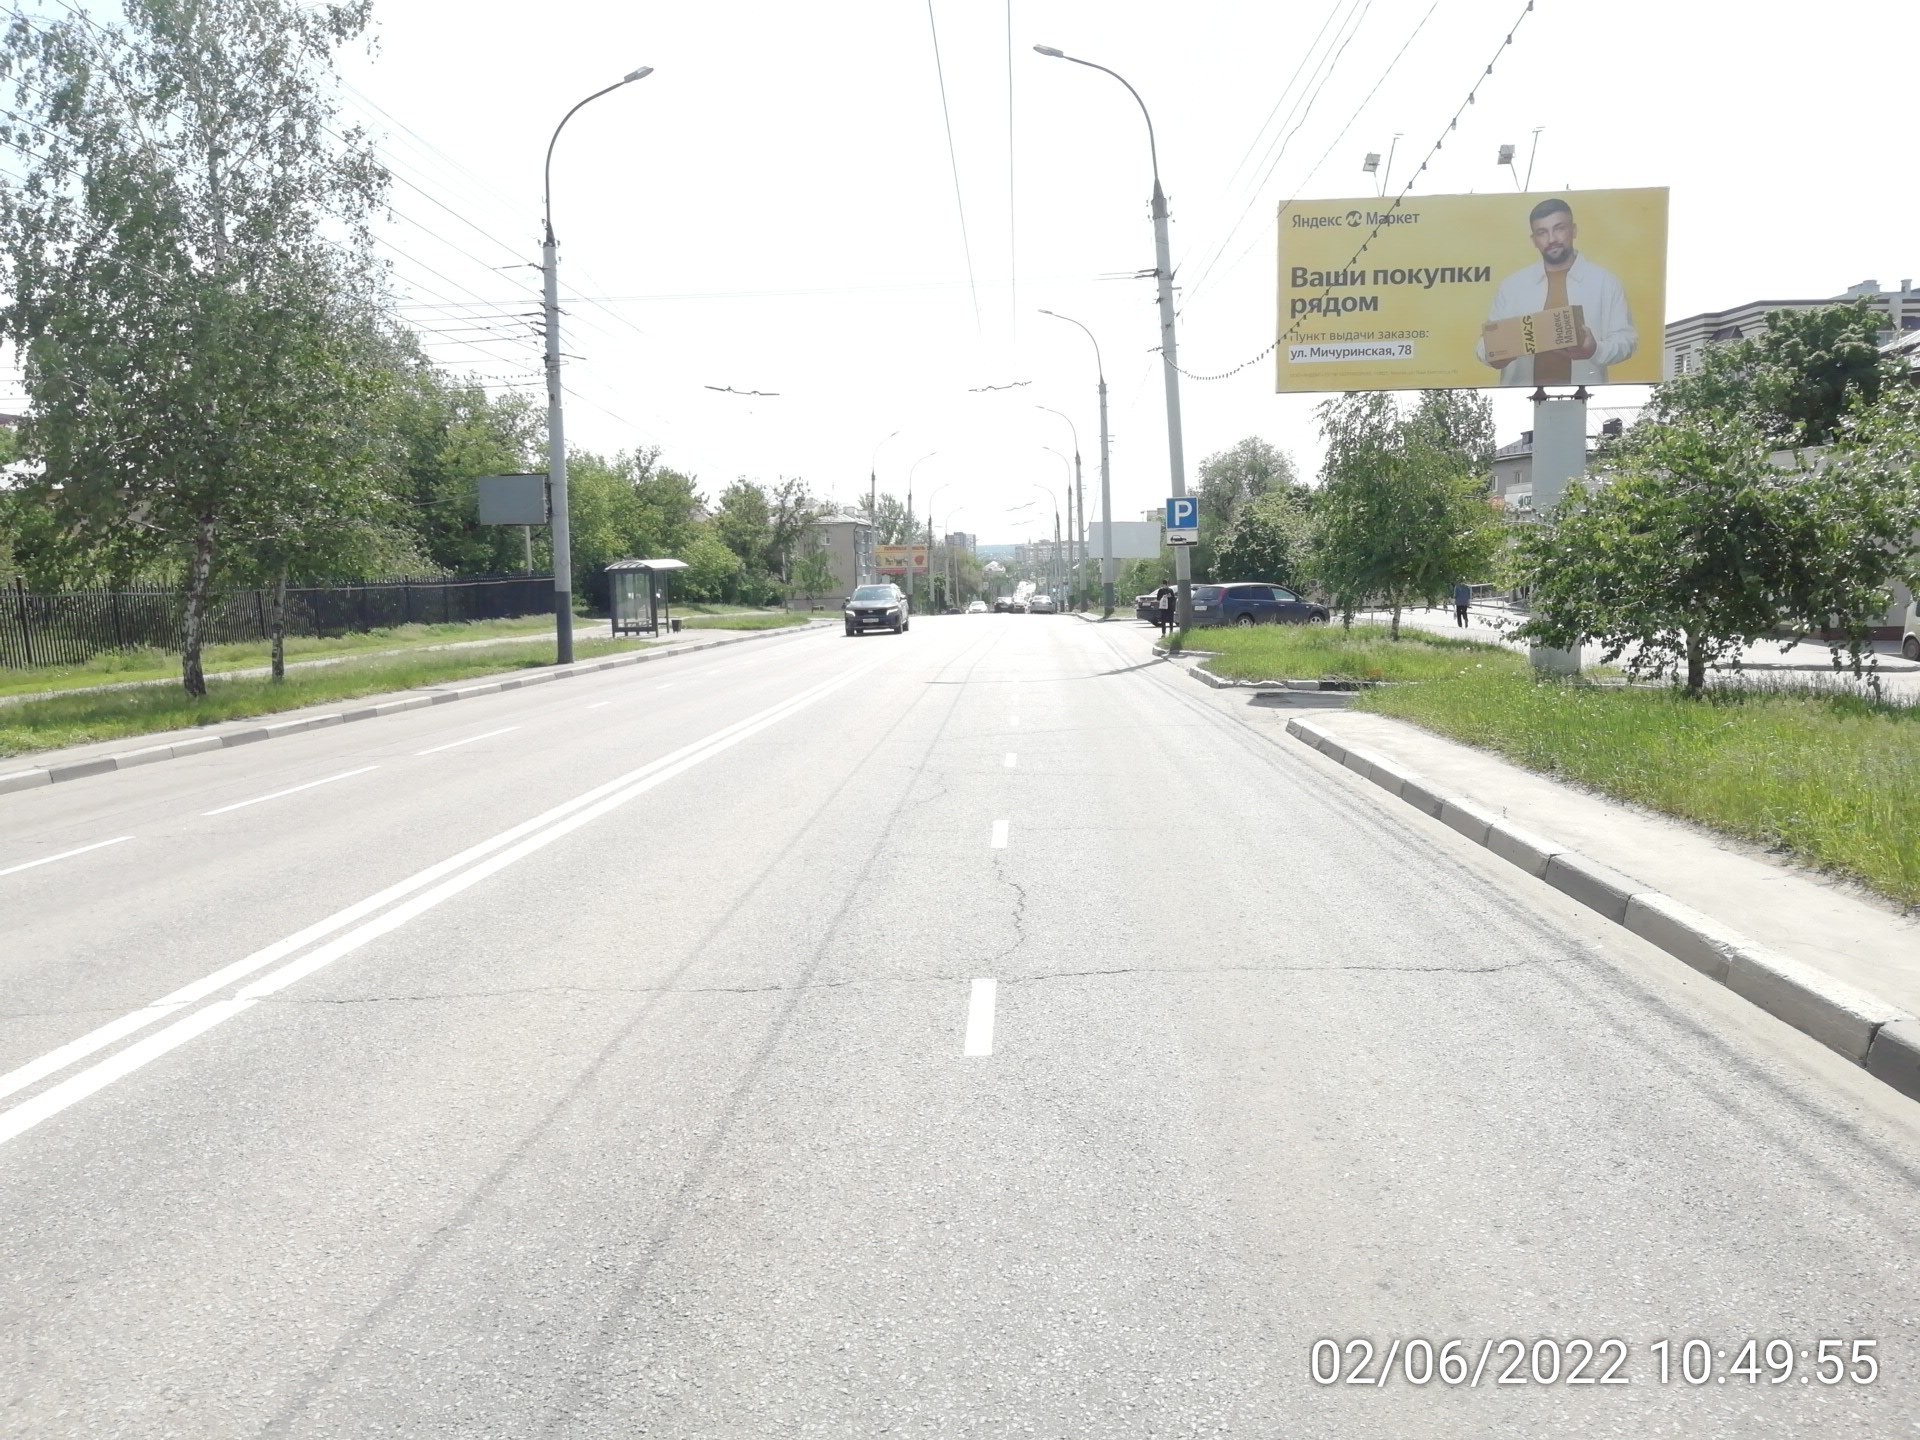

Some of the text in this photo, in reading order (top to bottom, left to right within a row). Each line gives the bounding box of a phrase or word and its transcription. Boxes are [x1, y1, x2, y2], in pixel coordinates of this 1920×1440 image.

[1291, 212, 1421, 229] Яндекс Маркет
[1291, 266, 1491, 290] Ваши покупки
[1290, 296, 1379, 319] рядом
[1290, 329, 1430, 343] Пункт выдачи заказов:
[1553, 312, 1564, 345] Яндекс
[1563, 310, 1574, 344] Маркет
[1290, 345, 1412, 360] ул. Мичуринская, 78
